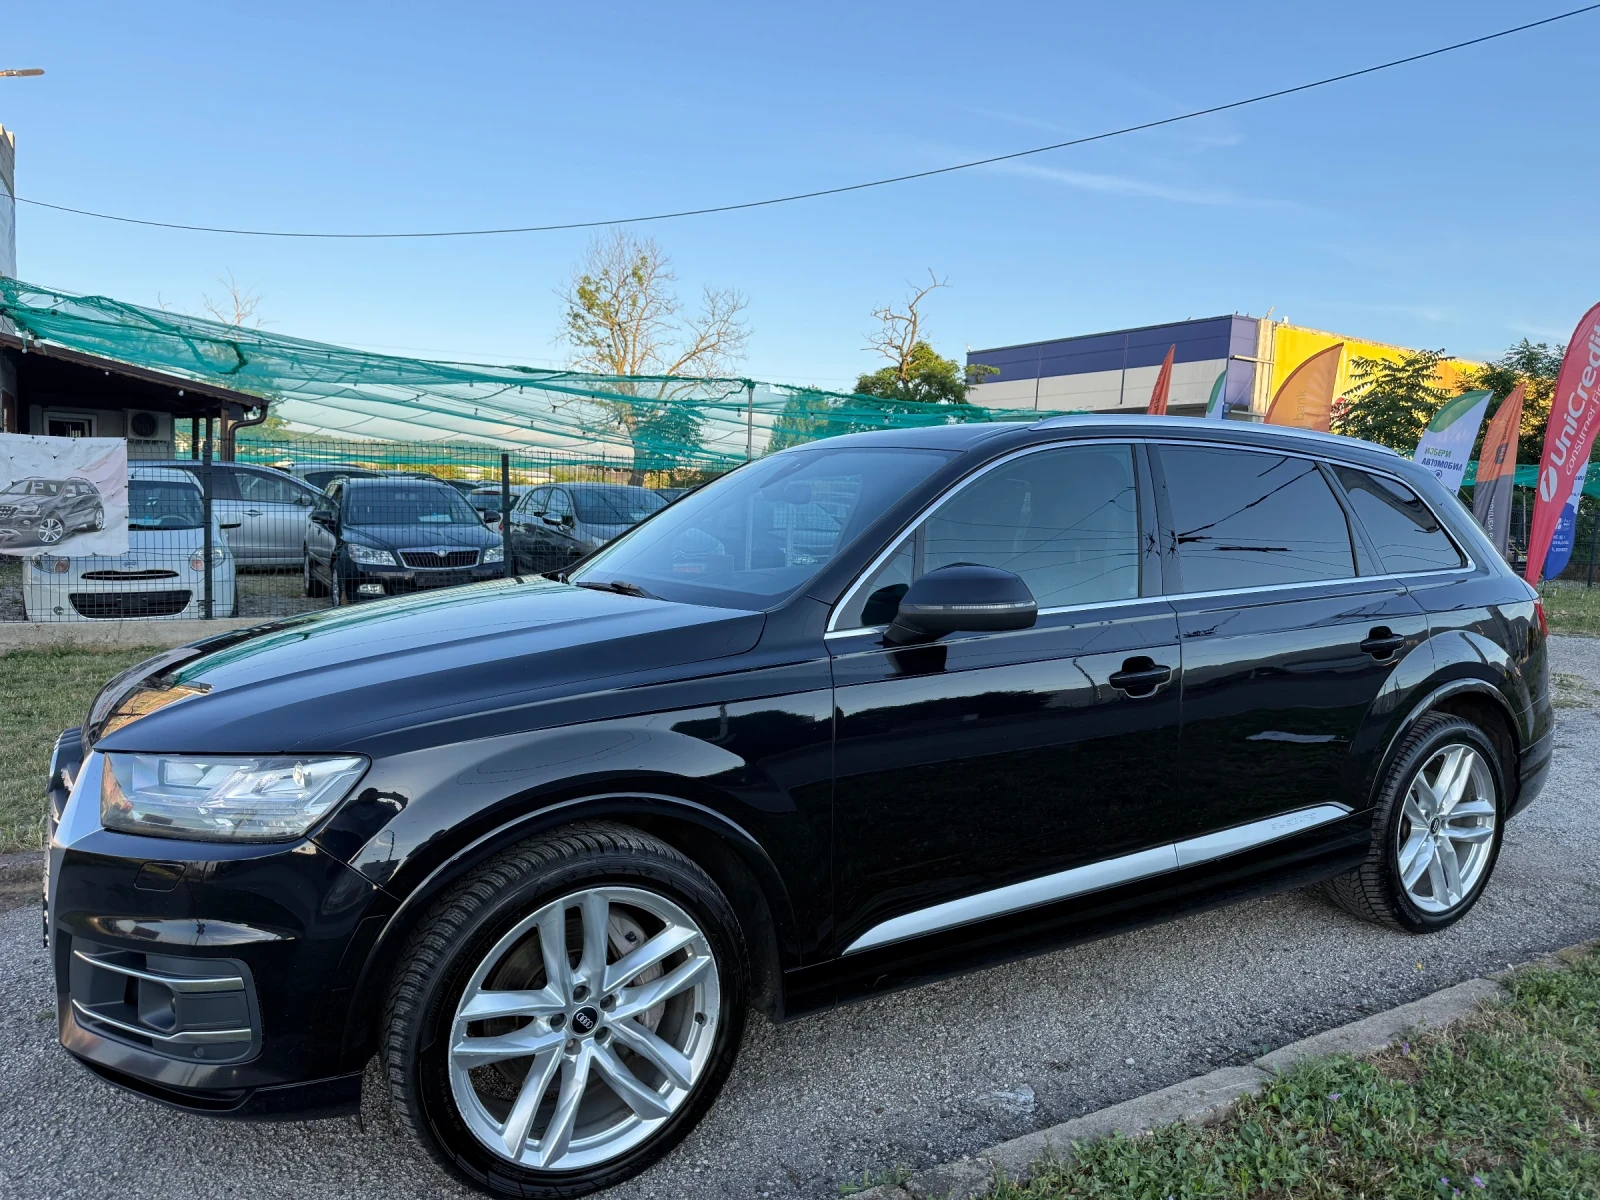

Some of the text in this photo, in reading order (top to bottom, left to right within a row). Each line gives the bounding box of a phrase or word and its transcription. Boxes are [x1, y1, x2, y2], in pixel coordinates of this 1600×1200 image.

[1292, 389, 1307, 421] bank
[1424, 446, 1452, 458] ИЗБЕРИ
[1421, 457, 1463, 472] АВТОМОБИЛ
